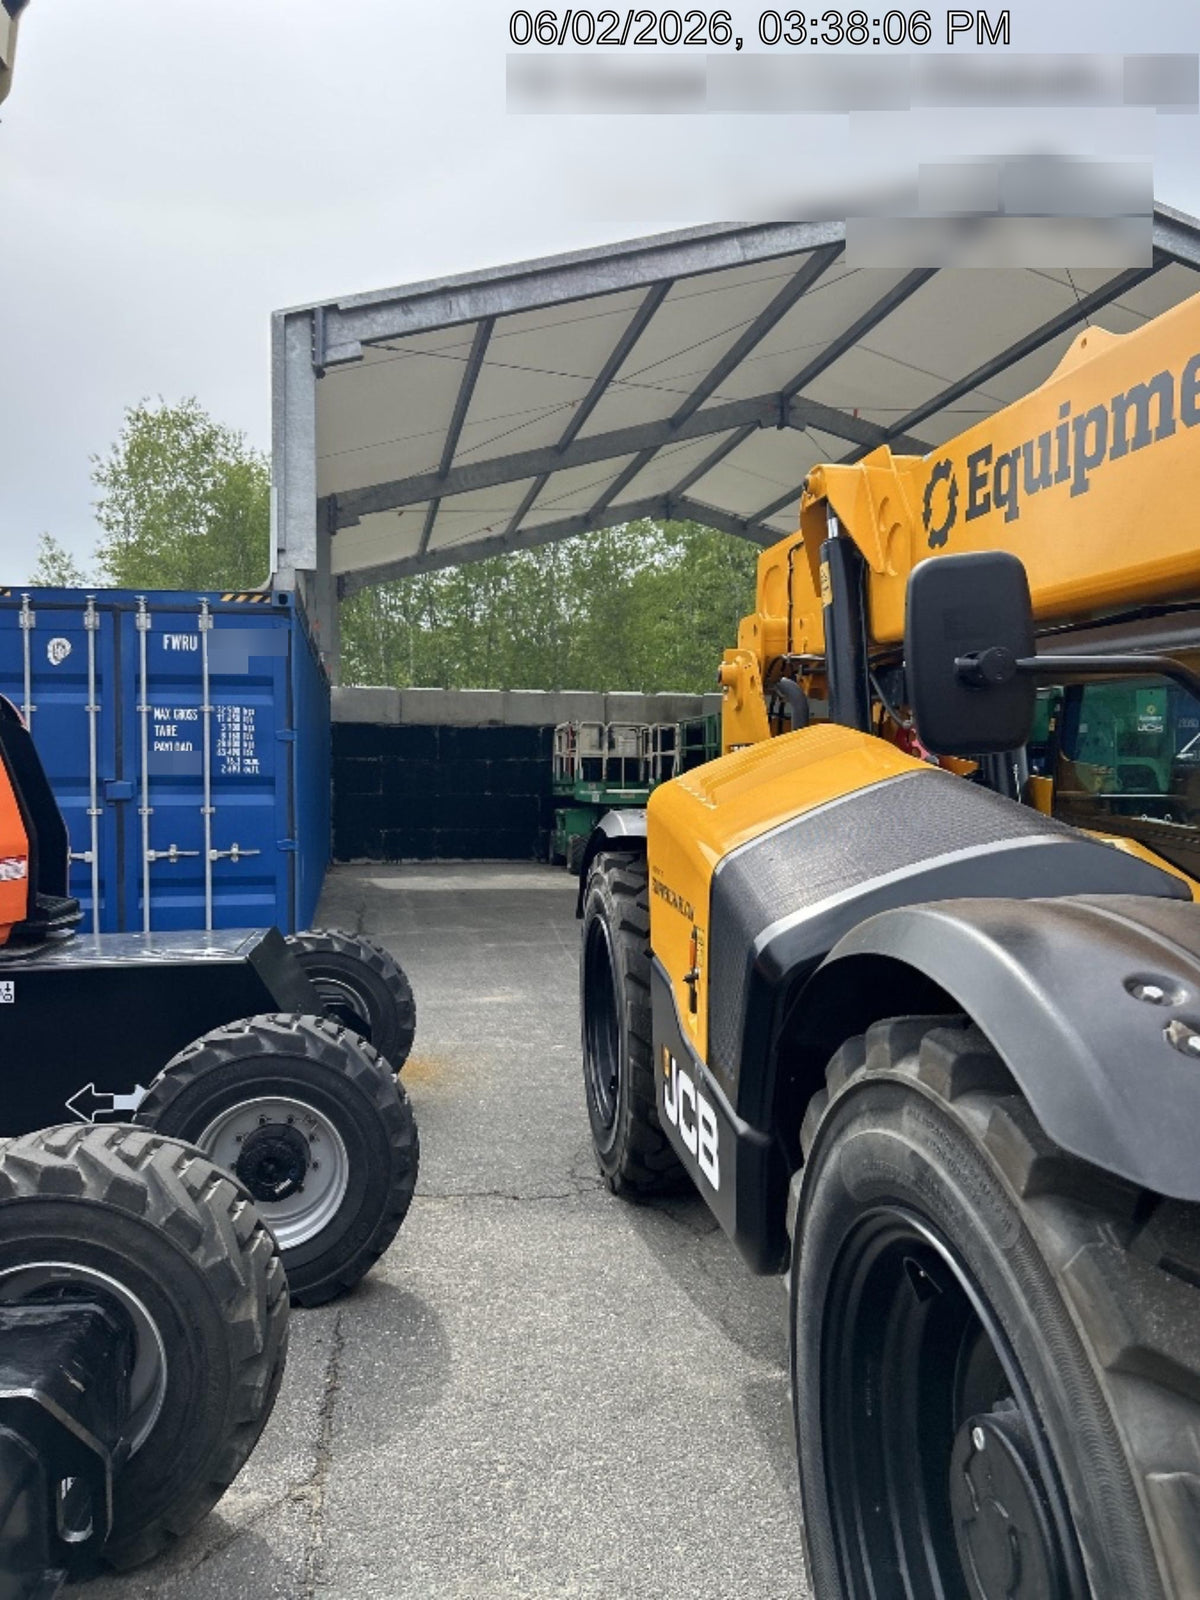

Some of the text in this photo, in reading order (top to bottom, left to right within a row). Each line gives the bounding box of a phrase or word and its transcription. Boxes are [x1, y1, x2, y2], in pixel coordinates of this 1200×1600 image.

[163, 634, 198, 651] FWRU
[154, 707, 198, 721] MAX GROSS
[154, 725, 178, 737] TARE
[664, 1057, 720, 1191] JCB
